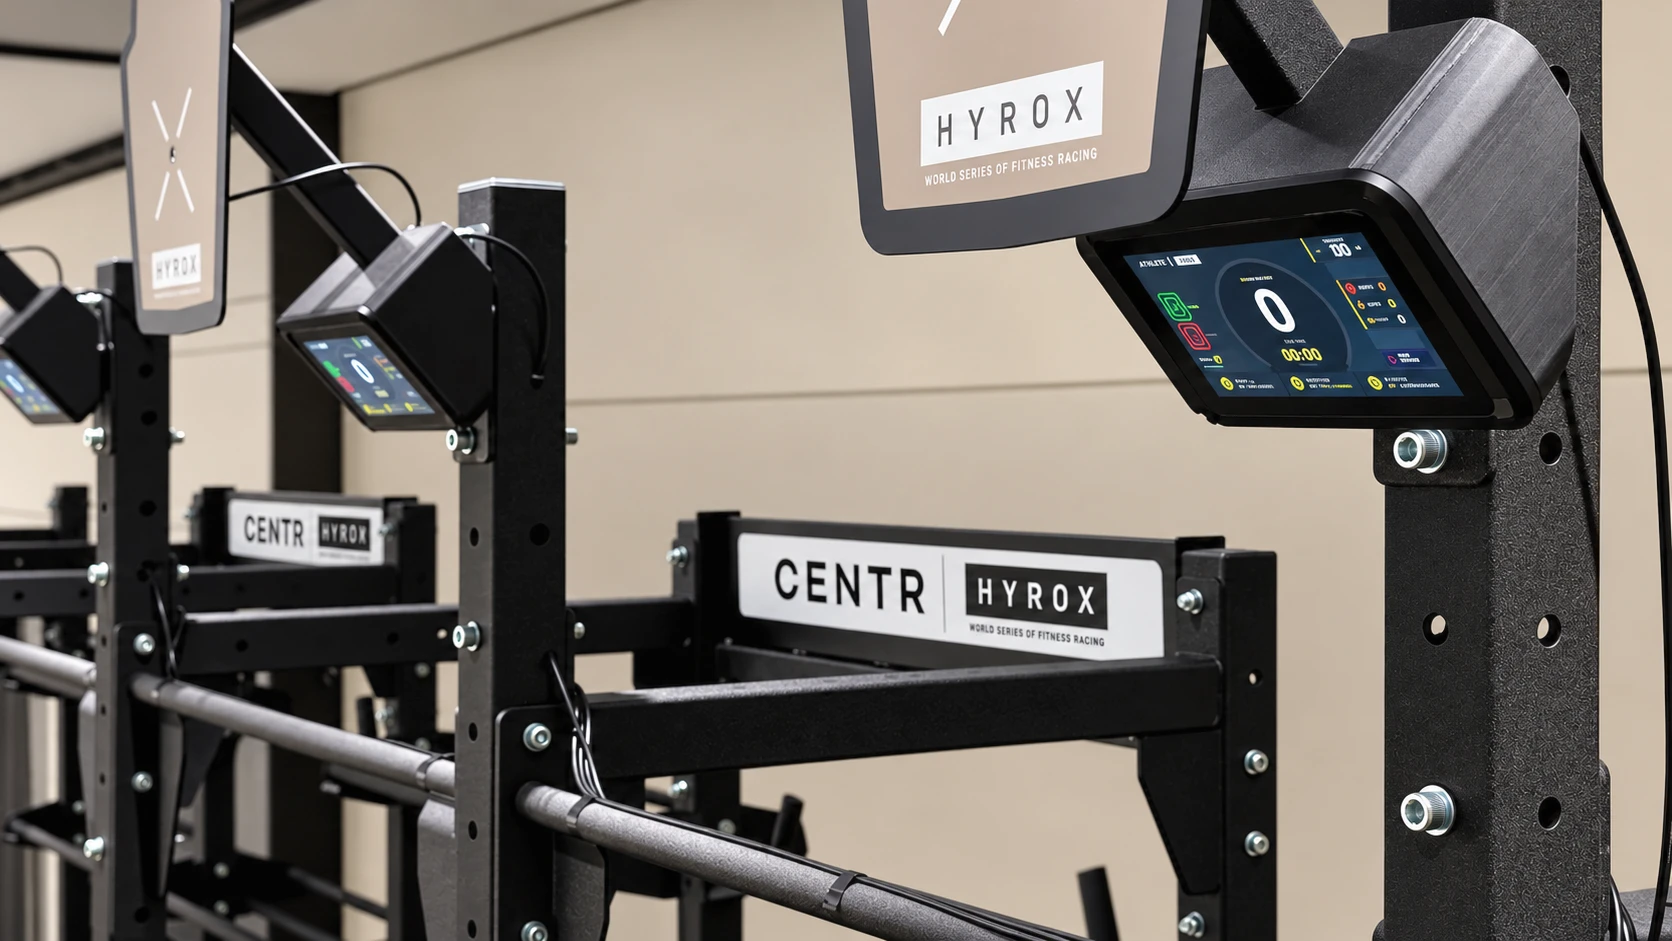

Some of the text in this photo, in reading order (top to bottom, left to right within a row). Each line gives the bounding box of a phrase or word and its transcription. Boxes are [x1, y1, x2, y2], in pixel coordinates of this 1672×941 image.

[937, 86, 1084, 148] HYROX
[924, 147, 1098, 186] WORLD SERIES OF FITNESS RACING
[156, 254, 197, 280] HYROX
[1254, 288, 1296, 333] 0
[1281, 347, 1323, 362] 00:00
[244, 514, 367, 547] CENTR HYROX
[774, 558, 1095, 615] CENTR HYROX
[969, 623, 1105, 647] WORLD SERIES OF FITNESS RACING
